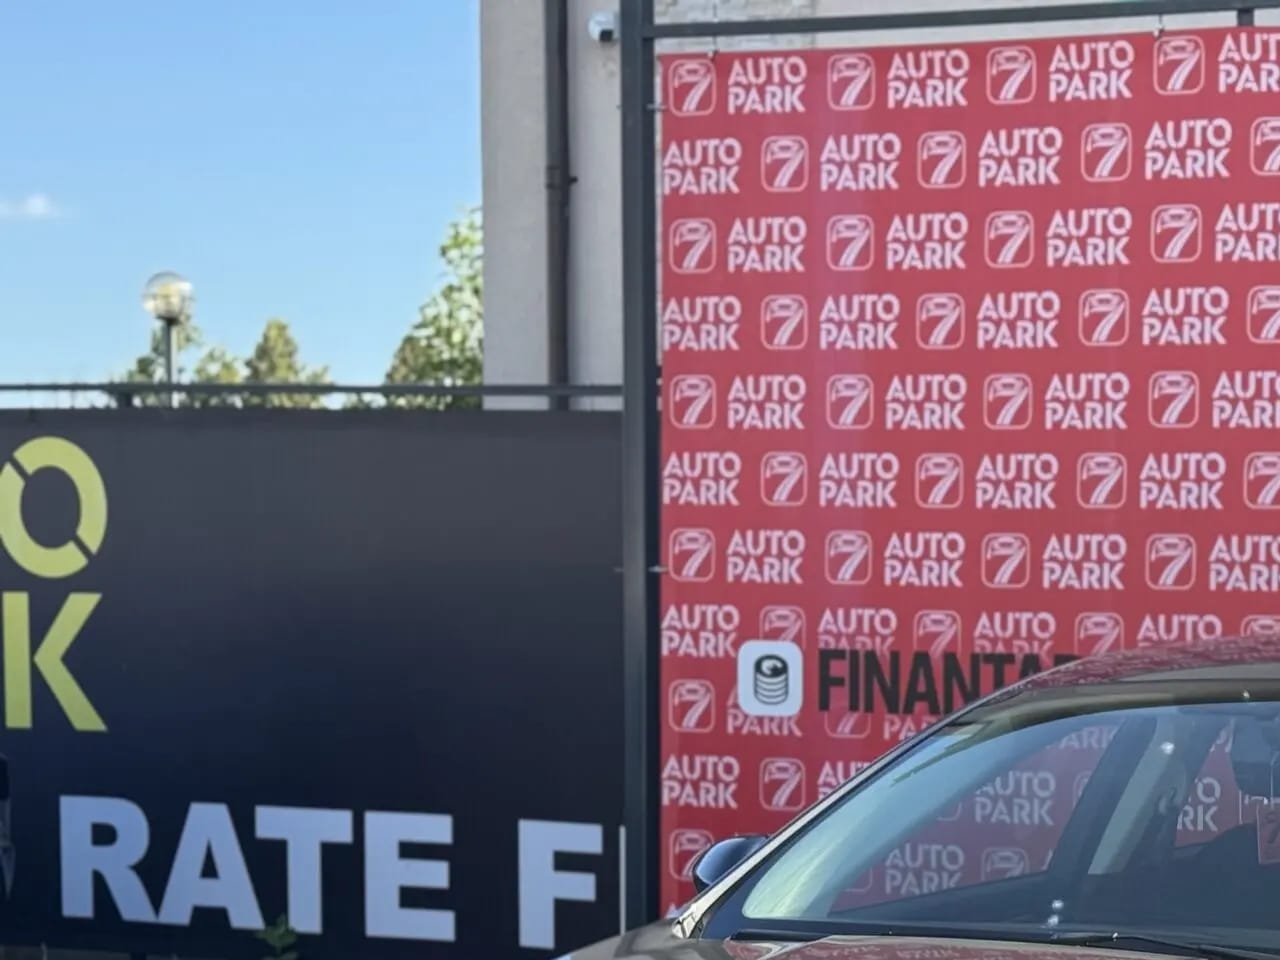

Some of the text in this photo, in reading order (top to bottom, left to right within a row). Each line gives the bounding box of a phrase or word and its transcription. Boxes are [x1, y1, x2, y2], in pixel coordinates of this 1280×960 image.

[888, 49, 969, 79] AUTO
[1049, 40, 1134, 72] AUTO
[728, 56, 806, 86] AUTO
[728, 84, 805, 114] PARK
[888, 77, 968, 108] PARK
[1049, 69, 1132, 102] PARK
[820, 133, 901, 163] AUTO
[979, 127, 1062, 158] AUTO
[1145, 118, 1232, 151] AUTO
[663, 138, 741, 168] AUTO
[1145, 148, 1229, 180] PARK
[663, 166, 739, 194] PARK
[821, 162, 898, 191] PARK
[979, 156, 1059, 187] PARK
[728, 216, 806, 244] AUTO
[886, 212, 968, 242] AUTO
[1047, 207, 1132, 237] AUTO
[728, 244, 804, 272] PARK
[887, 241, 965, 270] PARK
[1047, 237, 1129, 266] PARK
[663, 297, 741, 324] AUTO
[820, 294, 899, 323] AUTO
[977, 291, 1060, 320] AUTO
[1142, 287, 1228, 316] AUTO
[662, 323, 739, 350] PARK
[820, 322, 897, 349] PARK
[977, 320, 1058, 348] PARK
[1143, 316, 1226, 345] PARK
[728, 375, 806, 401] AUTO
[886, 374, 967, 401] AUTO
[1045, 372, 1129, 400] AUTO
[728, 402, 804, 429] PARK
[886, 402, 964, 429] PARK
[1046, 401, 1127, 429] PARK
[663, 452, 741, 478] AUTO
[819, 453, 899, 479] AUTO
[976, 453, 1058, 480] AUTO
[1140, 452, 1226, 480] AUTO
[663, 477, 738, 505] PARK
[820, 480, 896, 507] PARK
[976, 480, 1055, 509] PARK
[1140, 481, 1223, 509] PARK
[727, 530, 805, 556] AUTO
[884, 532, 965, 559] AUTO
[1043, 534, 1126, 561] AUTO
[727, 555, 802, 584] PARK
[885, 558, 962, 587] PARK
[1043, 561, 1124, 589] PARK
[662, 605, 739, 631] AUTO
[819, 608, 897, 635] AUTO
[975, 612, 1056, 640] AUTO
[1138, 615, 1222, 642] AUTO
[662, 629, 737, 658] PARK
[727, 708, 802, 736] PARK
[662, 754, 740, 782] AUTO
[662, 780, 737, 808] PARK
[975, 798, 1054, 825] PARK
[885, 843, 963, 871] AUTO
[59, 795, 623, 950] RATE F
